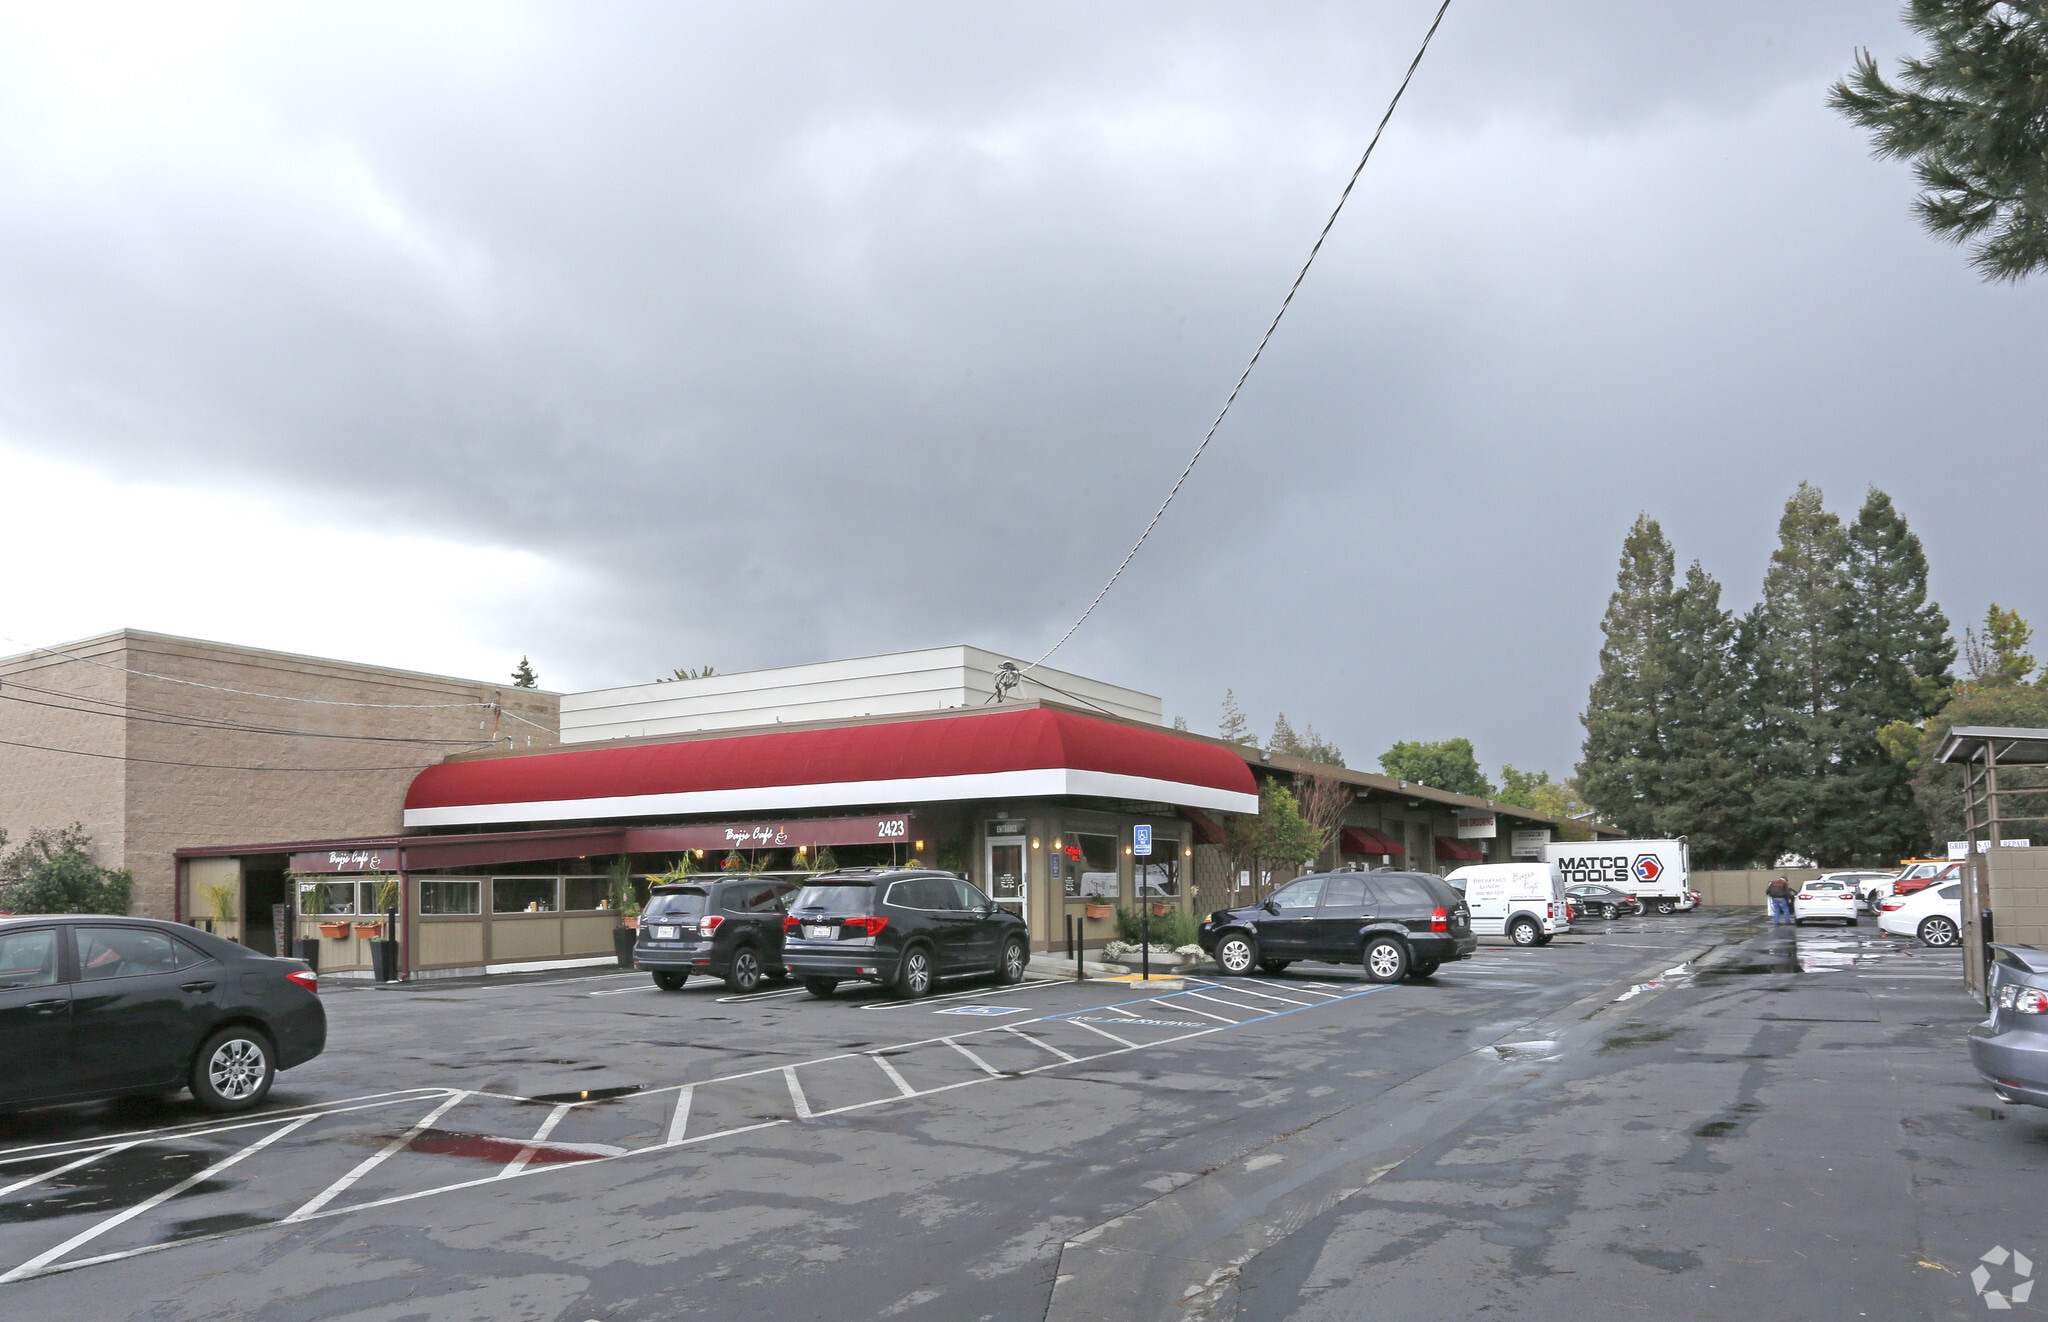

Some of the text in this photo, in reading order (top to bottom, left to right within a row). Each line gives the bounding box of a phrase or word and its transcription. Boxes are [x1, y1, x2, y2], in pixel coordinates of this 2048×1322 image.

[752, 826, 774, 845] Café
[878, 820, 905, 837] 2423
[996, 825, 1018, 833] ENTRANCE
[351, 850, 369, 869] Café
[1558, 856, 1629, 869] MATCO
[1560, 868, 1629, 882] TOOLS
